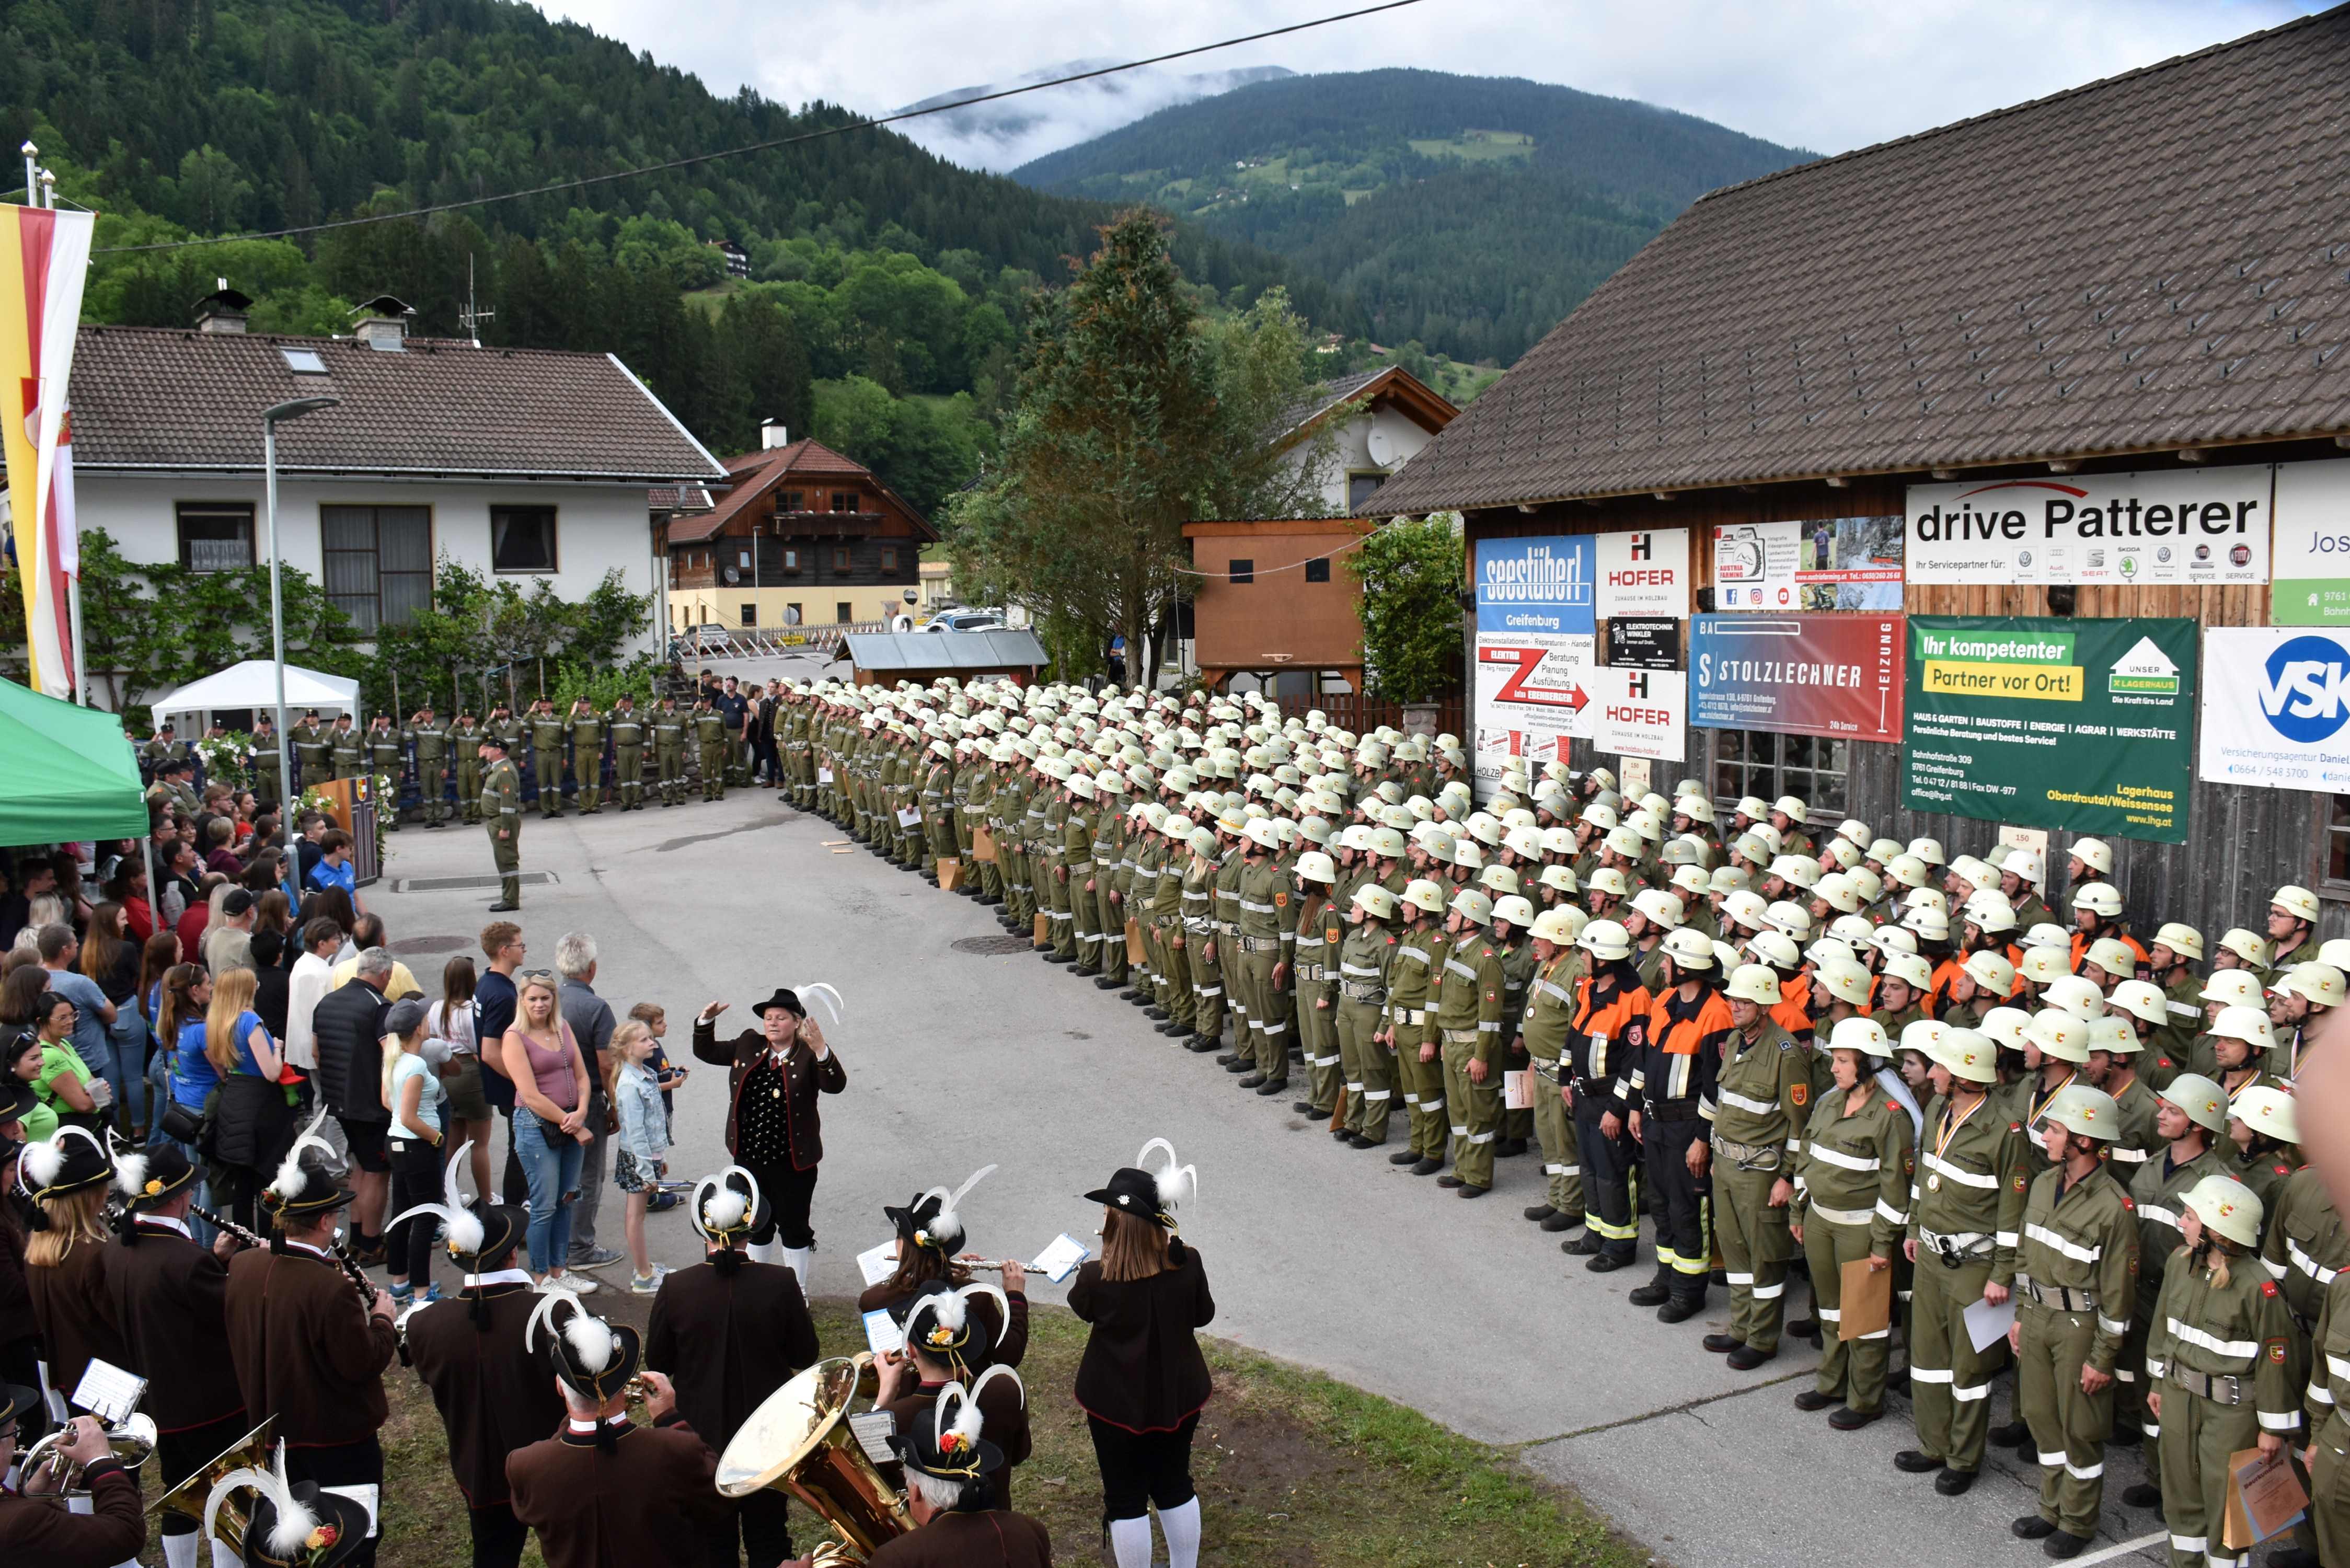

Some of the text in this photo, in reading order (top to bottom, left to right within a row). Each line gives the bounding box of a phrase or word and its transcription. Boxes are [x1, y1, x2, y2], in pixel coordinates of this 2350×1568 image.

[1917, 499, 2257, 541] drive Patterer
[1487, 545, 1581, 602] seestüberl
[1916, 560, 2005, 572] Ihr Servicepartner für:
[1609, 570, 1673, 586] HOFER
[2324, 592, 2346, 601] 9761
[1506, 614, 1560, 629] Greifenburg
[1479, 637, 1528, 645] Elektroinstallationen
[1535, 638, 1566, 648] Reparaturen
[1923, 636, 2066, 661] Ihr kompetenter
[1491, 650, 1519, 660] ELEKTRO
[1549, 653, 1579, 664] Beratung
[1542, 665, 1568, 676] Planung
[1719, 661, 1861, 688] STOLZLECHNER
[1533, 677, 1570, 689] Ausführung
[1933, 668, 2070, 693] Partner vor Ort!
[2122, 680, 2175, 689] LAGERHAUS
[1606, 706, 1670, 726] HOFER
[1829, 720, 1858, 731] 24h Service
[1914, 712, 1931, 722] HAUS
[1938, 714, 1968, 725] GARTEN
[1976, 718, 2021, 729] BAUSTOFFE
[2030, 721, 2065, 733] ENERGIE
[2075, 725, 2106, 735] AGRAR
[2116, 727, 2176, 740] WERKSTÄTTE
[1913, 725, 2057, 746] Persönliche Beratung und bestes Service!
[1614, 744, 1661, 756] www.holzbau-hofer.at
[1913, 750, 1972, 764] Bahnhofstraße 309
[2221, 747, 2317, 763] Versicherungsagentur
[1912, 762, 1964, 778] 9761 Greifenburg
[2234, 764, 2256, 774] 0664
[2267, 766, 2283, 776] 548
[2286, 768, 2308, 778] 3700
[1911, 775, 1922, 784] Tel.
[1972, 783, 1985, 792] Fax
[1986, 784, 1999, 793] DW
[2000, 786, 2017, 795] -977
[2117, 784, 2174, 800] Lagerhaus
[1911, 788, 1952, 801] office@lhg.at
[2047, 790, 2173, 813] Oberdrautal/Weissensee
[2126, 814, 2172, 828] www.lhg.at
[2243, 1459, 2284, 1490] Beurkundung
